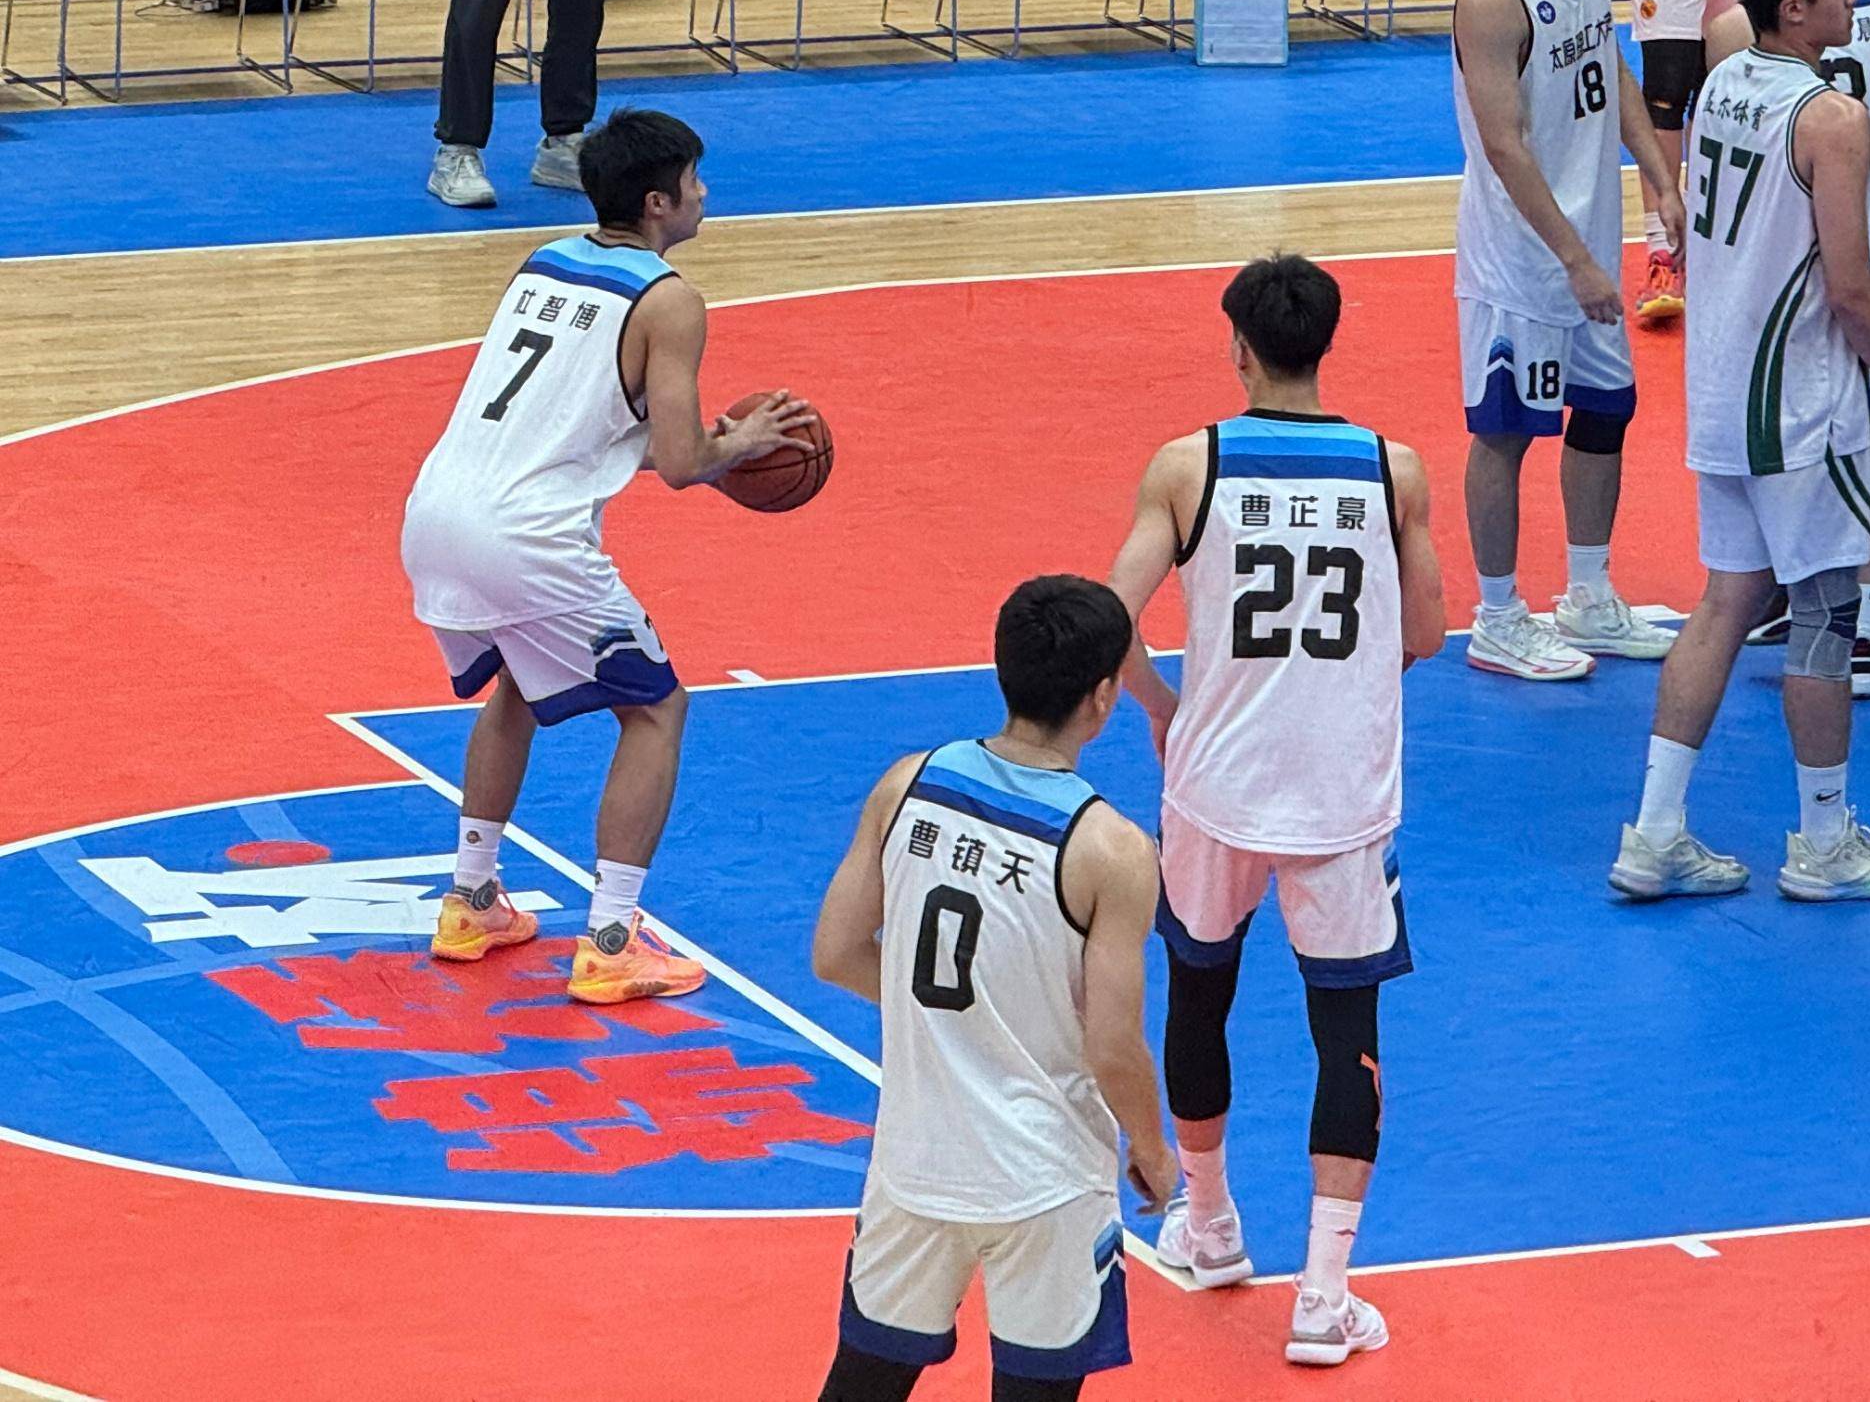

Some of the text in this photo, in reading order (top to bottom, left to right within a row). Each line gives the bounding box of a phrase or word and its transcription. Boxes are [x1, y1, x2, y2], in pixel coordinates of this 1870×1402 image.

[1574, 59, 1608, 121] 18
[1692, 134, 1766, 248] 37
[481, 327, 554, 423] 7
[1526, 359, 1562, 402] 18
[1241, 493, 1367, 531] 曹芷豪
[1231, 543, 1365, 662] 23
[908, 817, 1035, 895] 曹镇天
[912, 883, 984, 1012] 0
